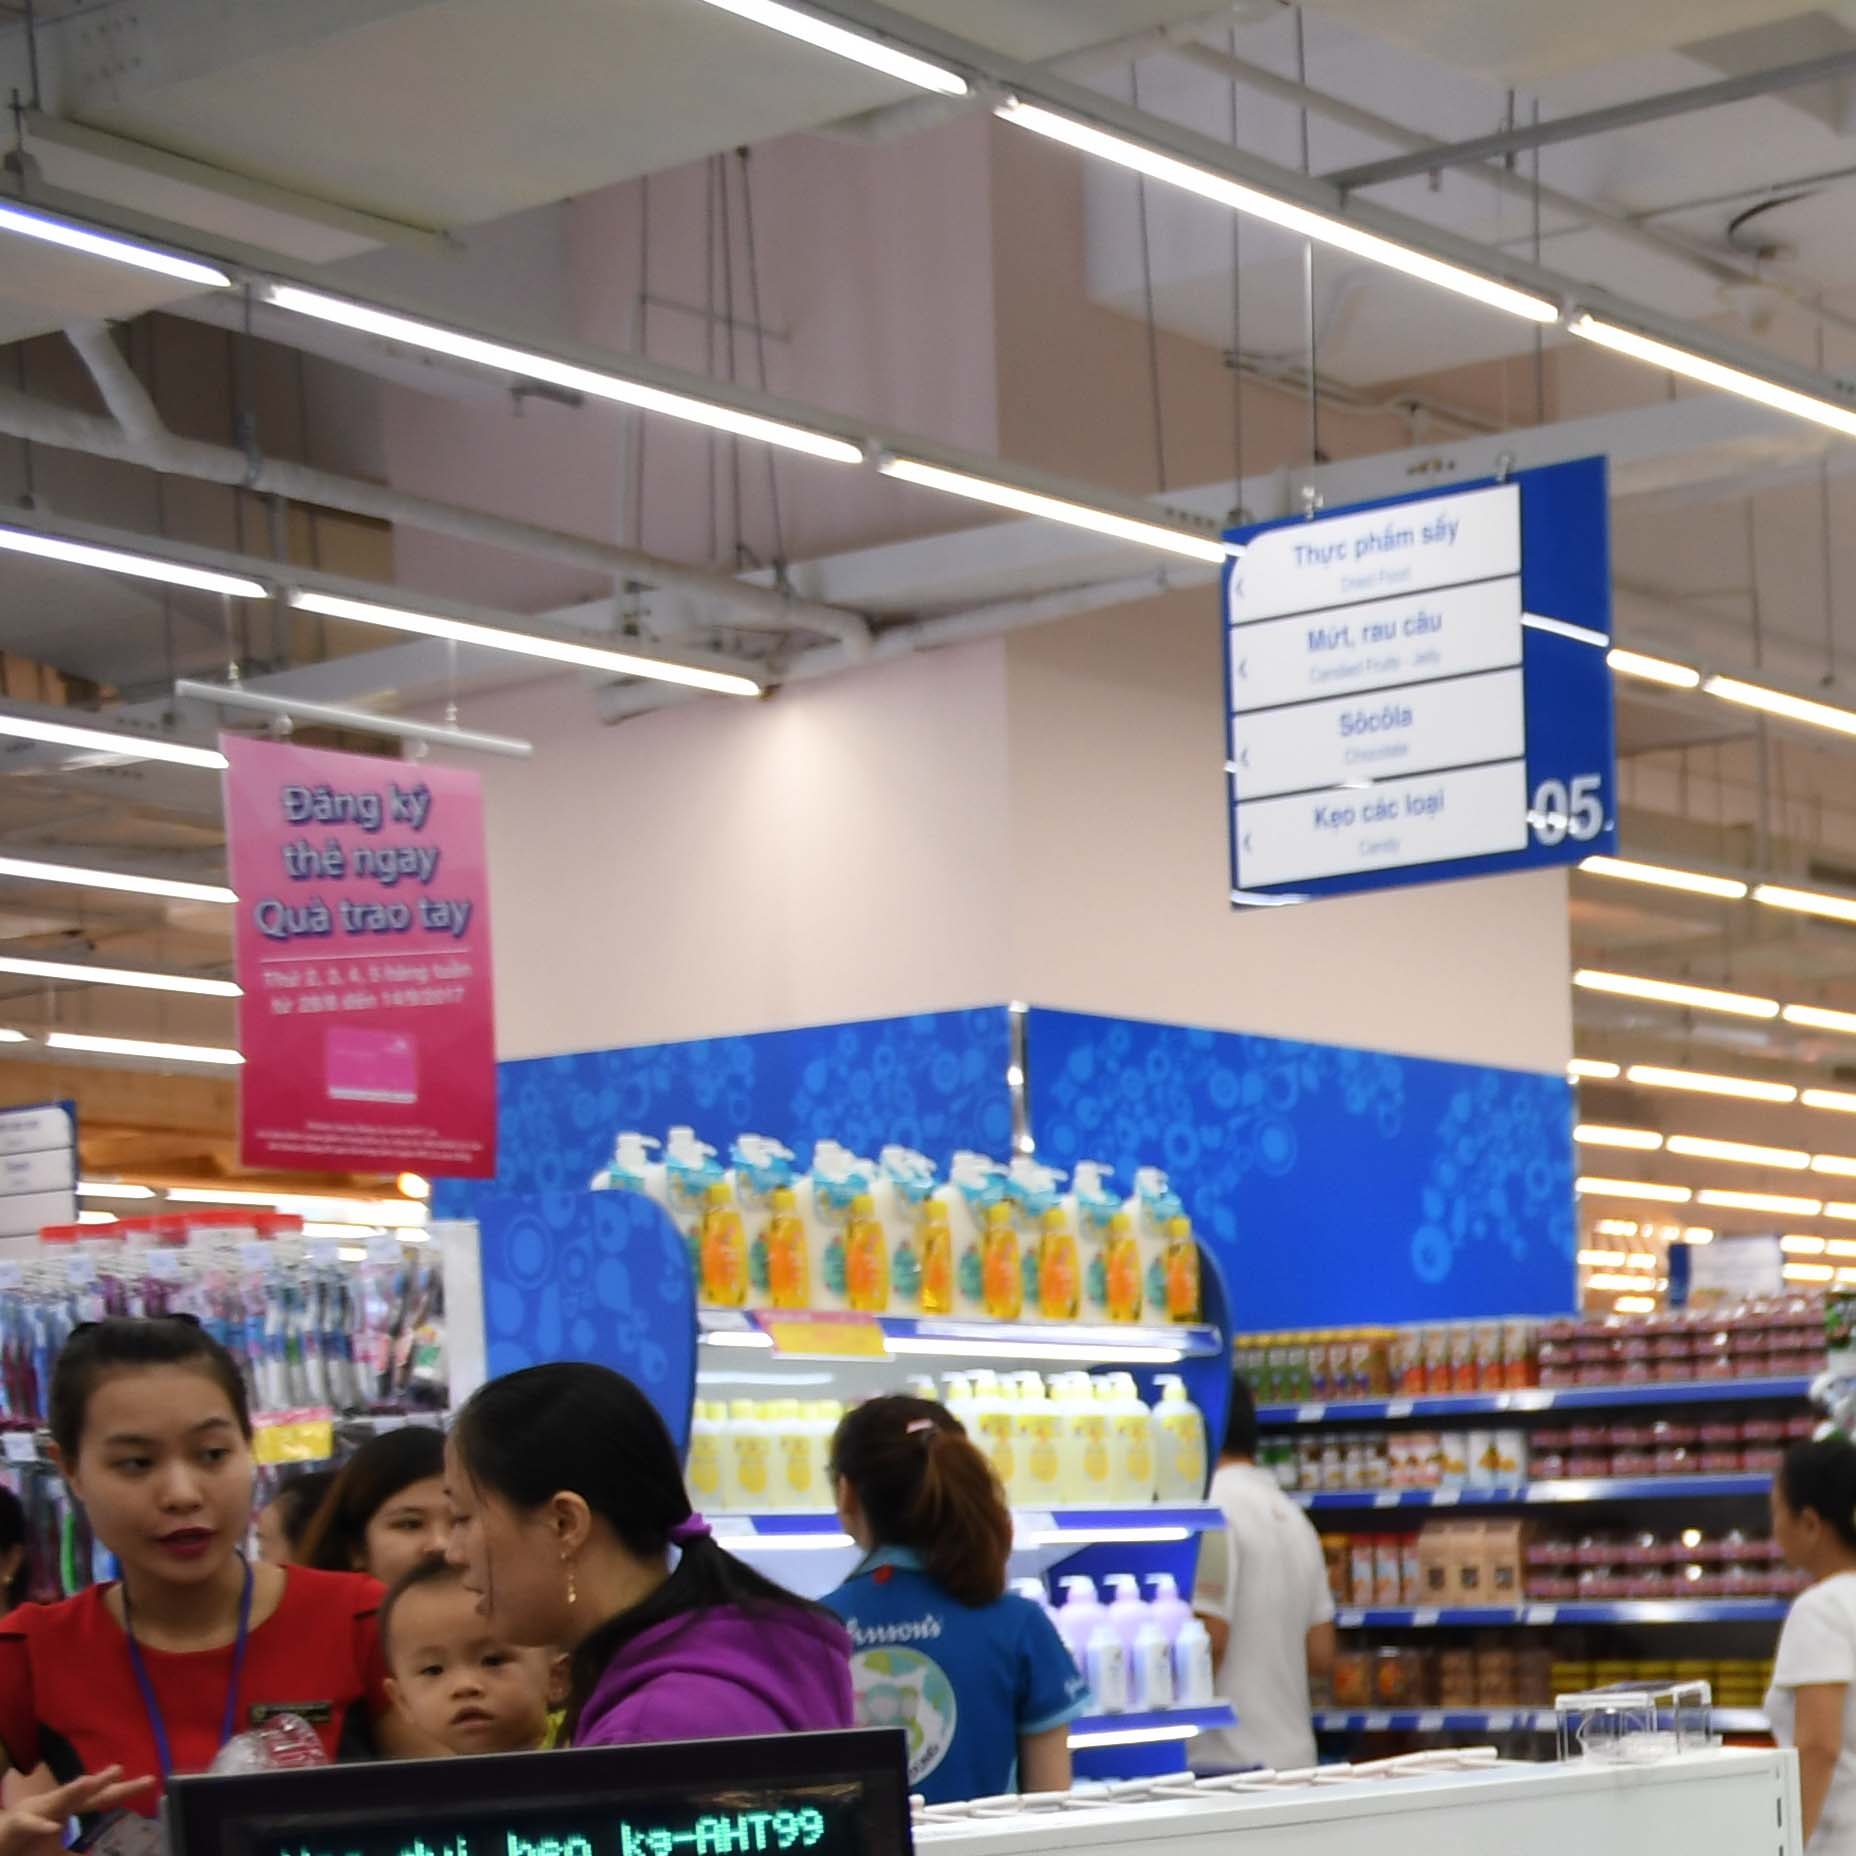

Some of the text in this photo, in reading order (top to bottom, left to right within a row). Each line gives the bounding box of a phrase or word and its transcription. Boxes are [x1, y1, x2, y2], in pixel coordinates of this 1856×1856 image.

[1362, 619, 1397, 644] rau
[1338, 706, 1414, 737] Sôcôla
[282, 782, 431, 832] Đăng ký
[1313, 789, 1445, 834] Kẹo các loại
[1531, 773, 1604, 847] 05
[283, 838, 439, 886] thẻ ngay
[338, 899, 412, 936] trao
[418, 897, 471, 938] tay
